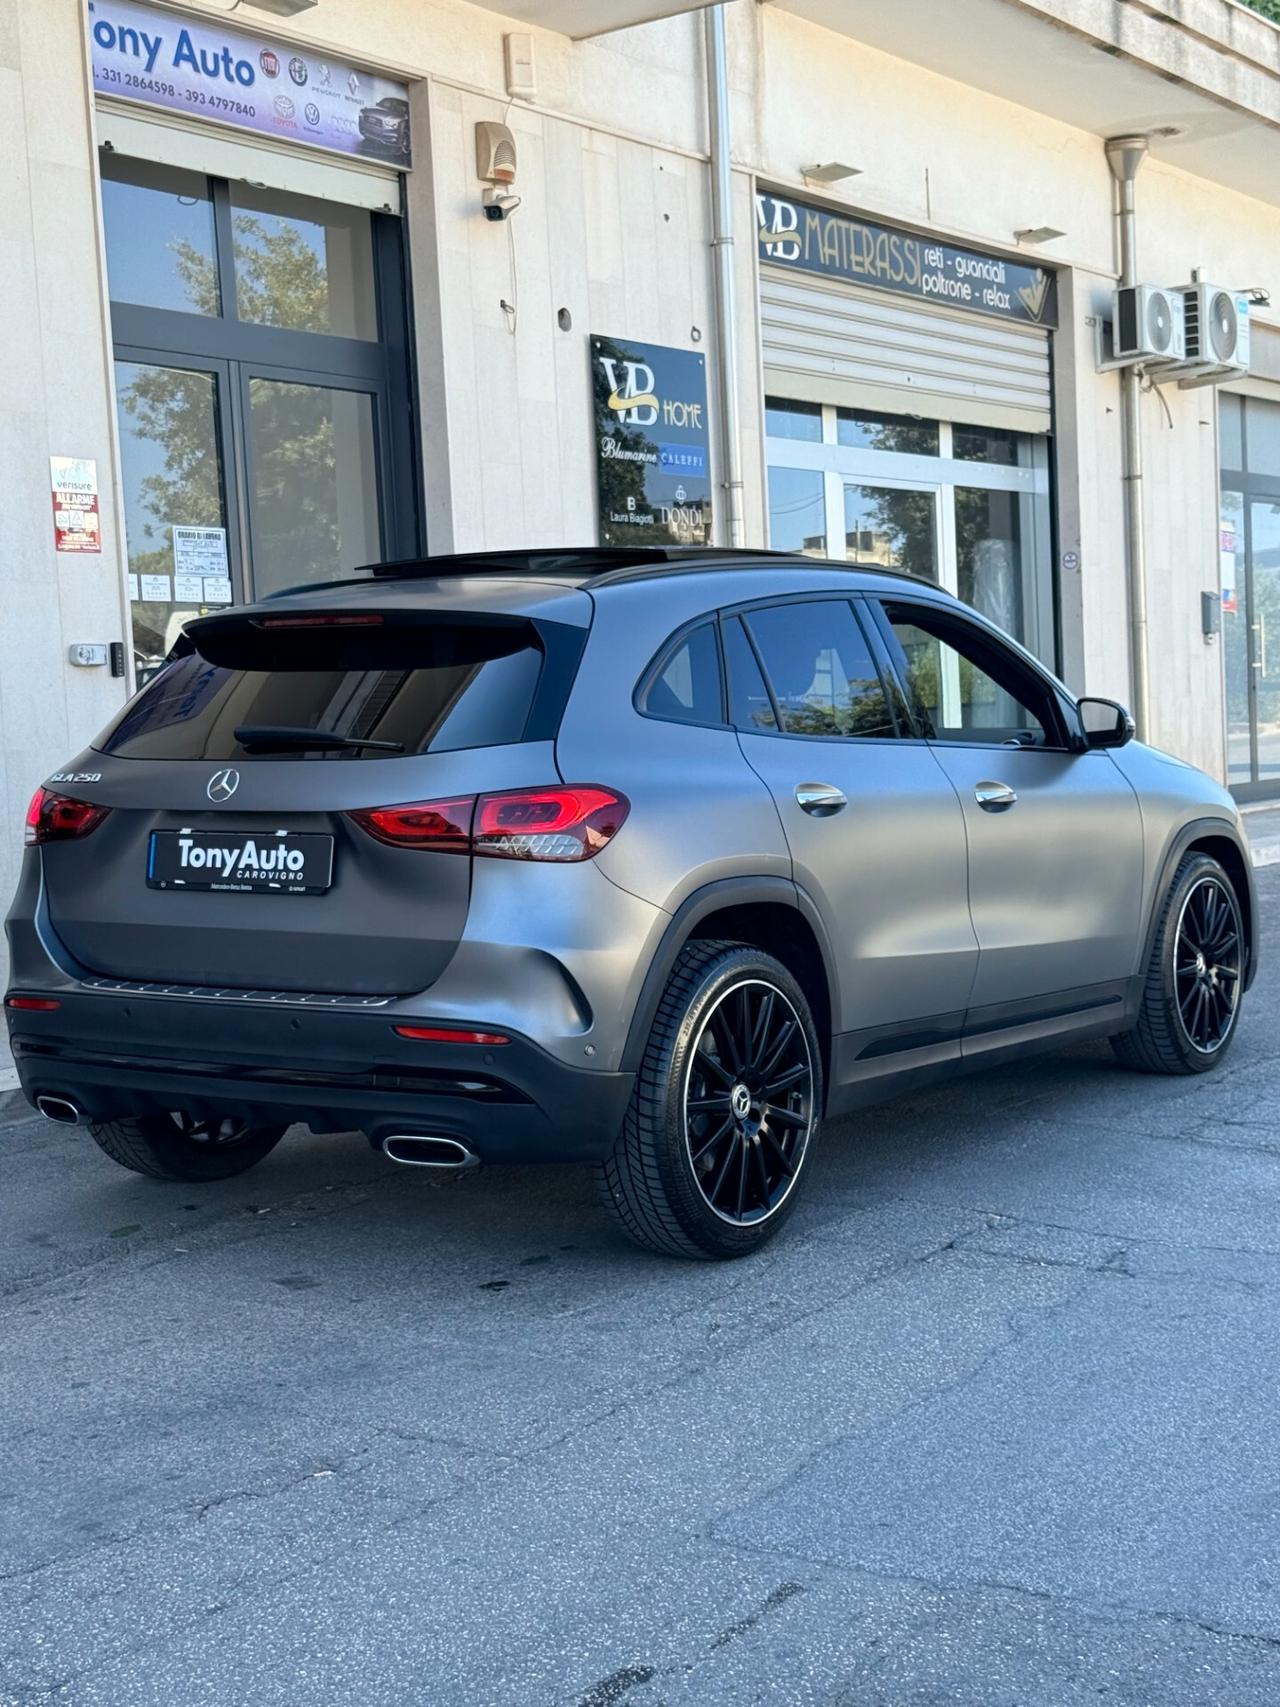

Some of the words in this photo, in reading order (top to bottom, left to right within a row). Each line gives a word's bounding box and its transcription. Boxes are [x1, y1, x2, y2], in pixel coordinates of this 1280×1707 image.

[88, 2, 162, 73] ony
[172, 28, 256, 88] Auto
[102, 67, 122, 87] 331
[125, 73, 175, 97] 2864598
[185, 89, 206, 105] 393
[208, 95, 256, 118] 4797840
[804, 210, 922, 289] MATERASSI
[924, 247, 944, 268] reti
[955, 256, 1007, 285] guanciali
[922, 273, 972, 301] poltrone
[983, 284, 1011, 310] relax
[600, 356, 660, 426] VB
[663, 399, 703, 430] HOME
[601, 436, 657, 466] Blumarine
[56, 480, 93, 491] verisure
[610, 511, 629, 523] Laura
[627, 496, 637, 511] B
[661, 506, 703, 527] DONDI
[74, 772, 102, 783] 250
[236, 869, 305, 881] CAROVIGNO
